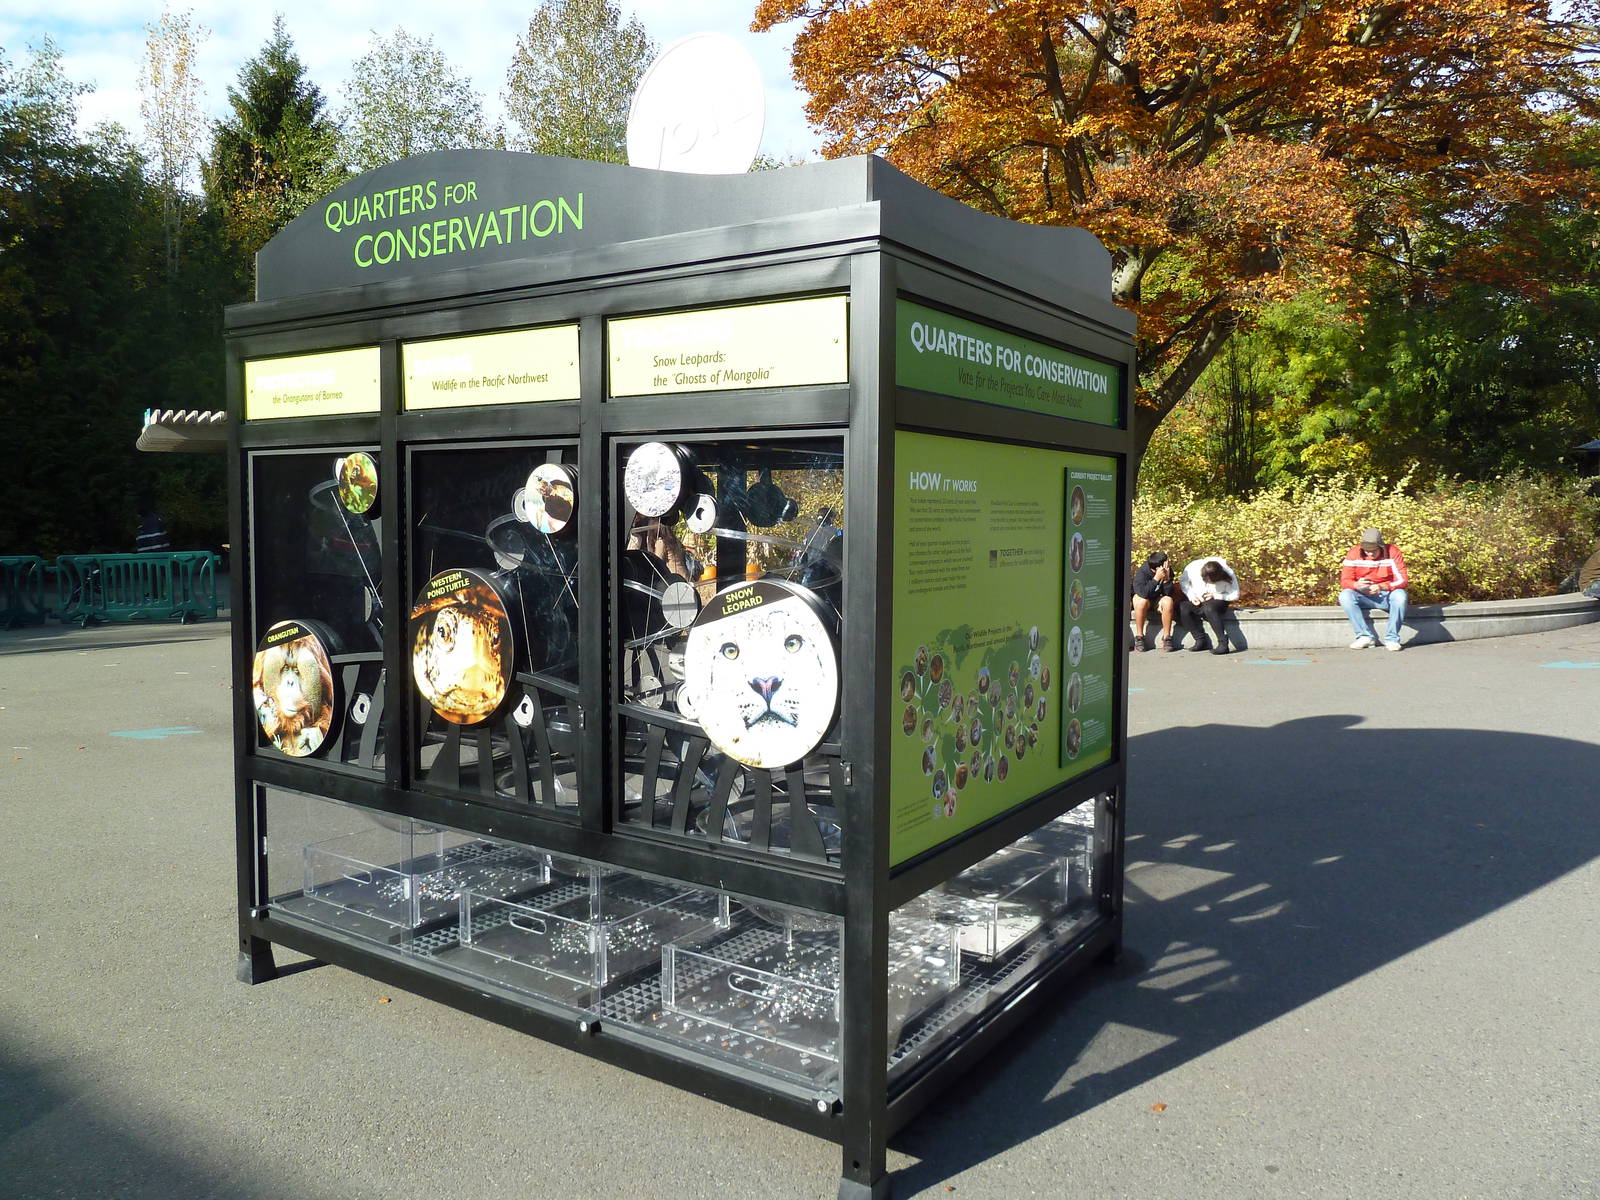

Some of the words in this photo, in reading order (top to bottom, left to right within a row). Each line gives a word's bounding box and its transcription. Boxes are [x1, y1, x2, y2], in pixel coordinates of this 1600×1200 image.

[325, 180, 437, 232] QUARTERS
[444, 181, 478, 206] FOR
[354, 192, 584, 267] CONSERVATION
[653, 355, 677, 367] Snow
[680, 350, 726, 367] Leopards:
[910, 321, 993, 366] QUARTERS
[996, 345, 1021, 374] FOR
[1024, 354, 1107, 395] CONSERVATION
[431, 378, 458, 392] Wildlife
[459, 380, 467, 389] in
[468, 378, 480, 388] the
[482, 374, 505, 388] Pacific
[507, 372, 549, 385] Northwest
[653, 374, 668, 387] the
[709, 369, 722, 388] of
[958, 367, 974, 386] Vote
[975, 371, 986, 391] for
[987, 375, 999, 391] the
[272, 394, 281, 404] the
[315, 390, 322, 402] of
[322, 390, 343, 400] Borneo
[909, 471, 942, 491] HOW
[942, 478, 951, 490] IT
[952, 479, 977, 493] WORKS
[426, 587, 446, 600] POND
[445, 577, 471, 593] TURTLE
[431, 571, 462, 589] WESTERN
[725, 586, 754, 603] SNOW
[722, 595, 763, 615] LEOPARD
[267, 627, 299, 643] ORANGUTAN
